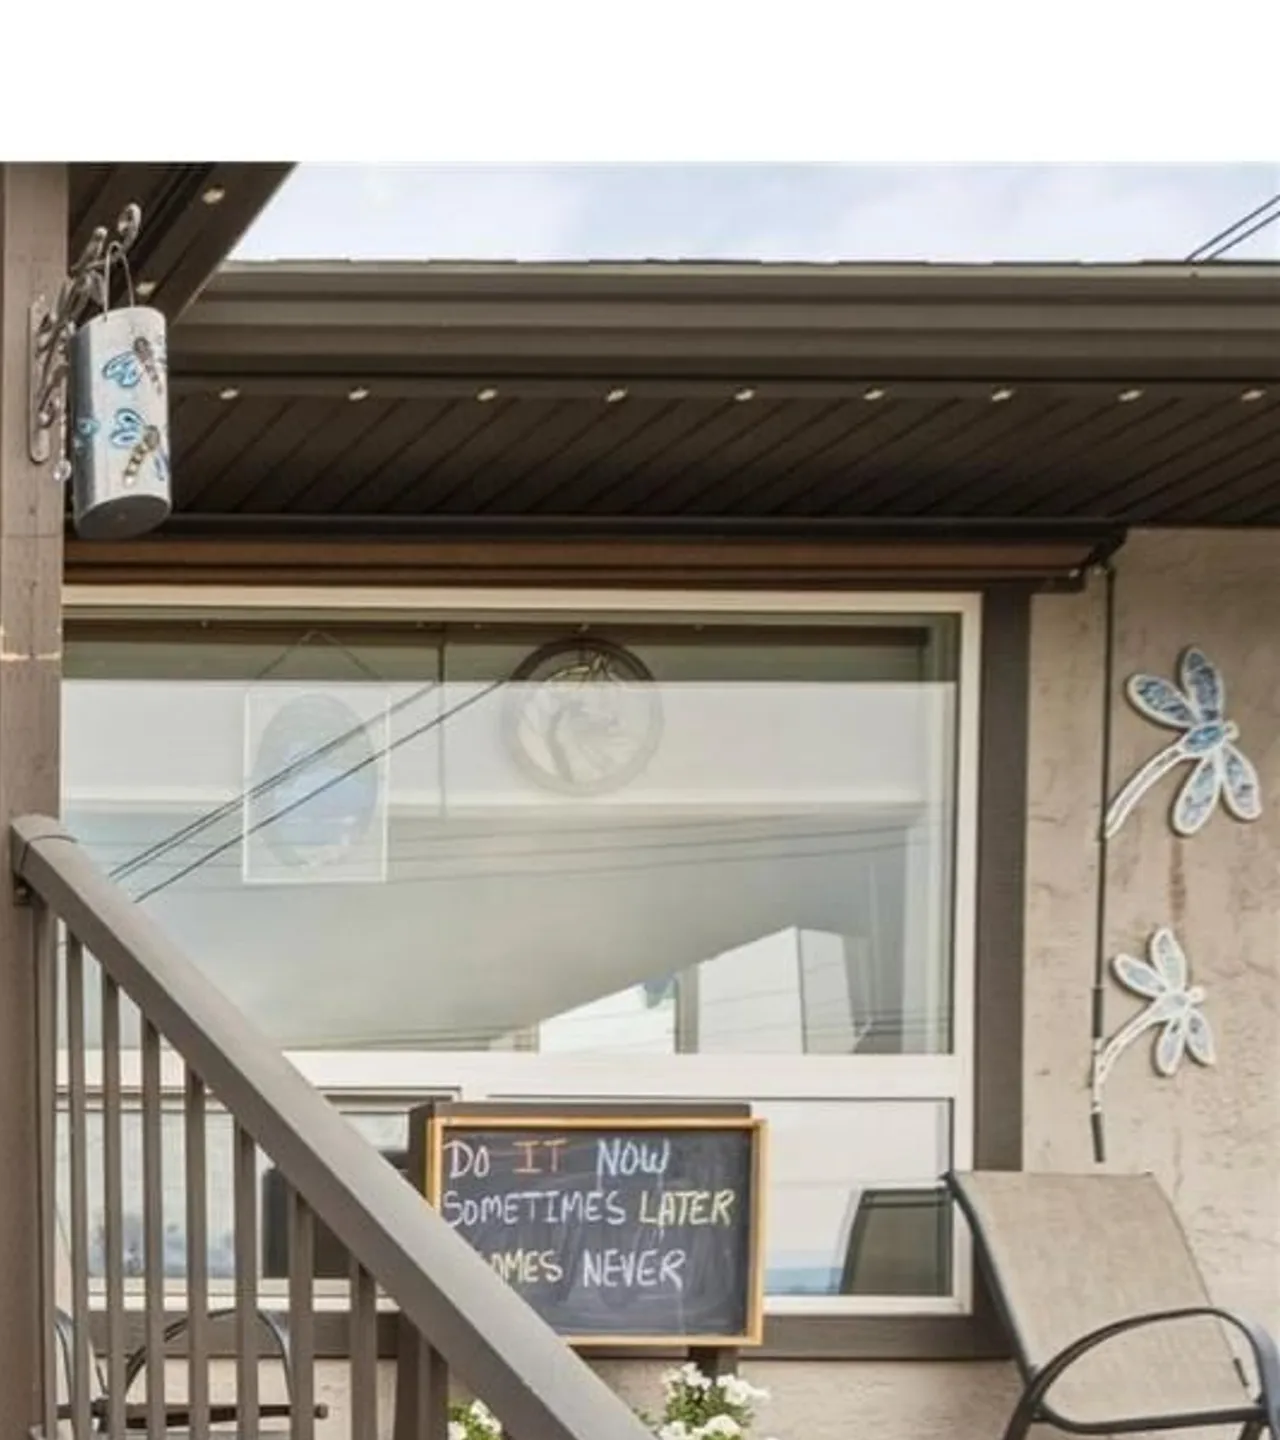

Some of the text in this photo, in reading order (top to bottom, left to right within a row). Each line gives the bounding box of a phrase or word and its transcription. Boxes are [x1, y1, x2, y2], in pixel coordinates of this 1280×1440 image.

[512, 1138, 568, 1174] IT
[596, 1138, 671, 1178] NOW
[443, 1189, 736, 1228] SOMETIMES LATER
[583, 1248, 687, 1292] NEVER
